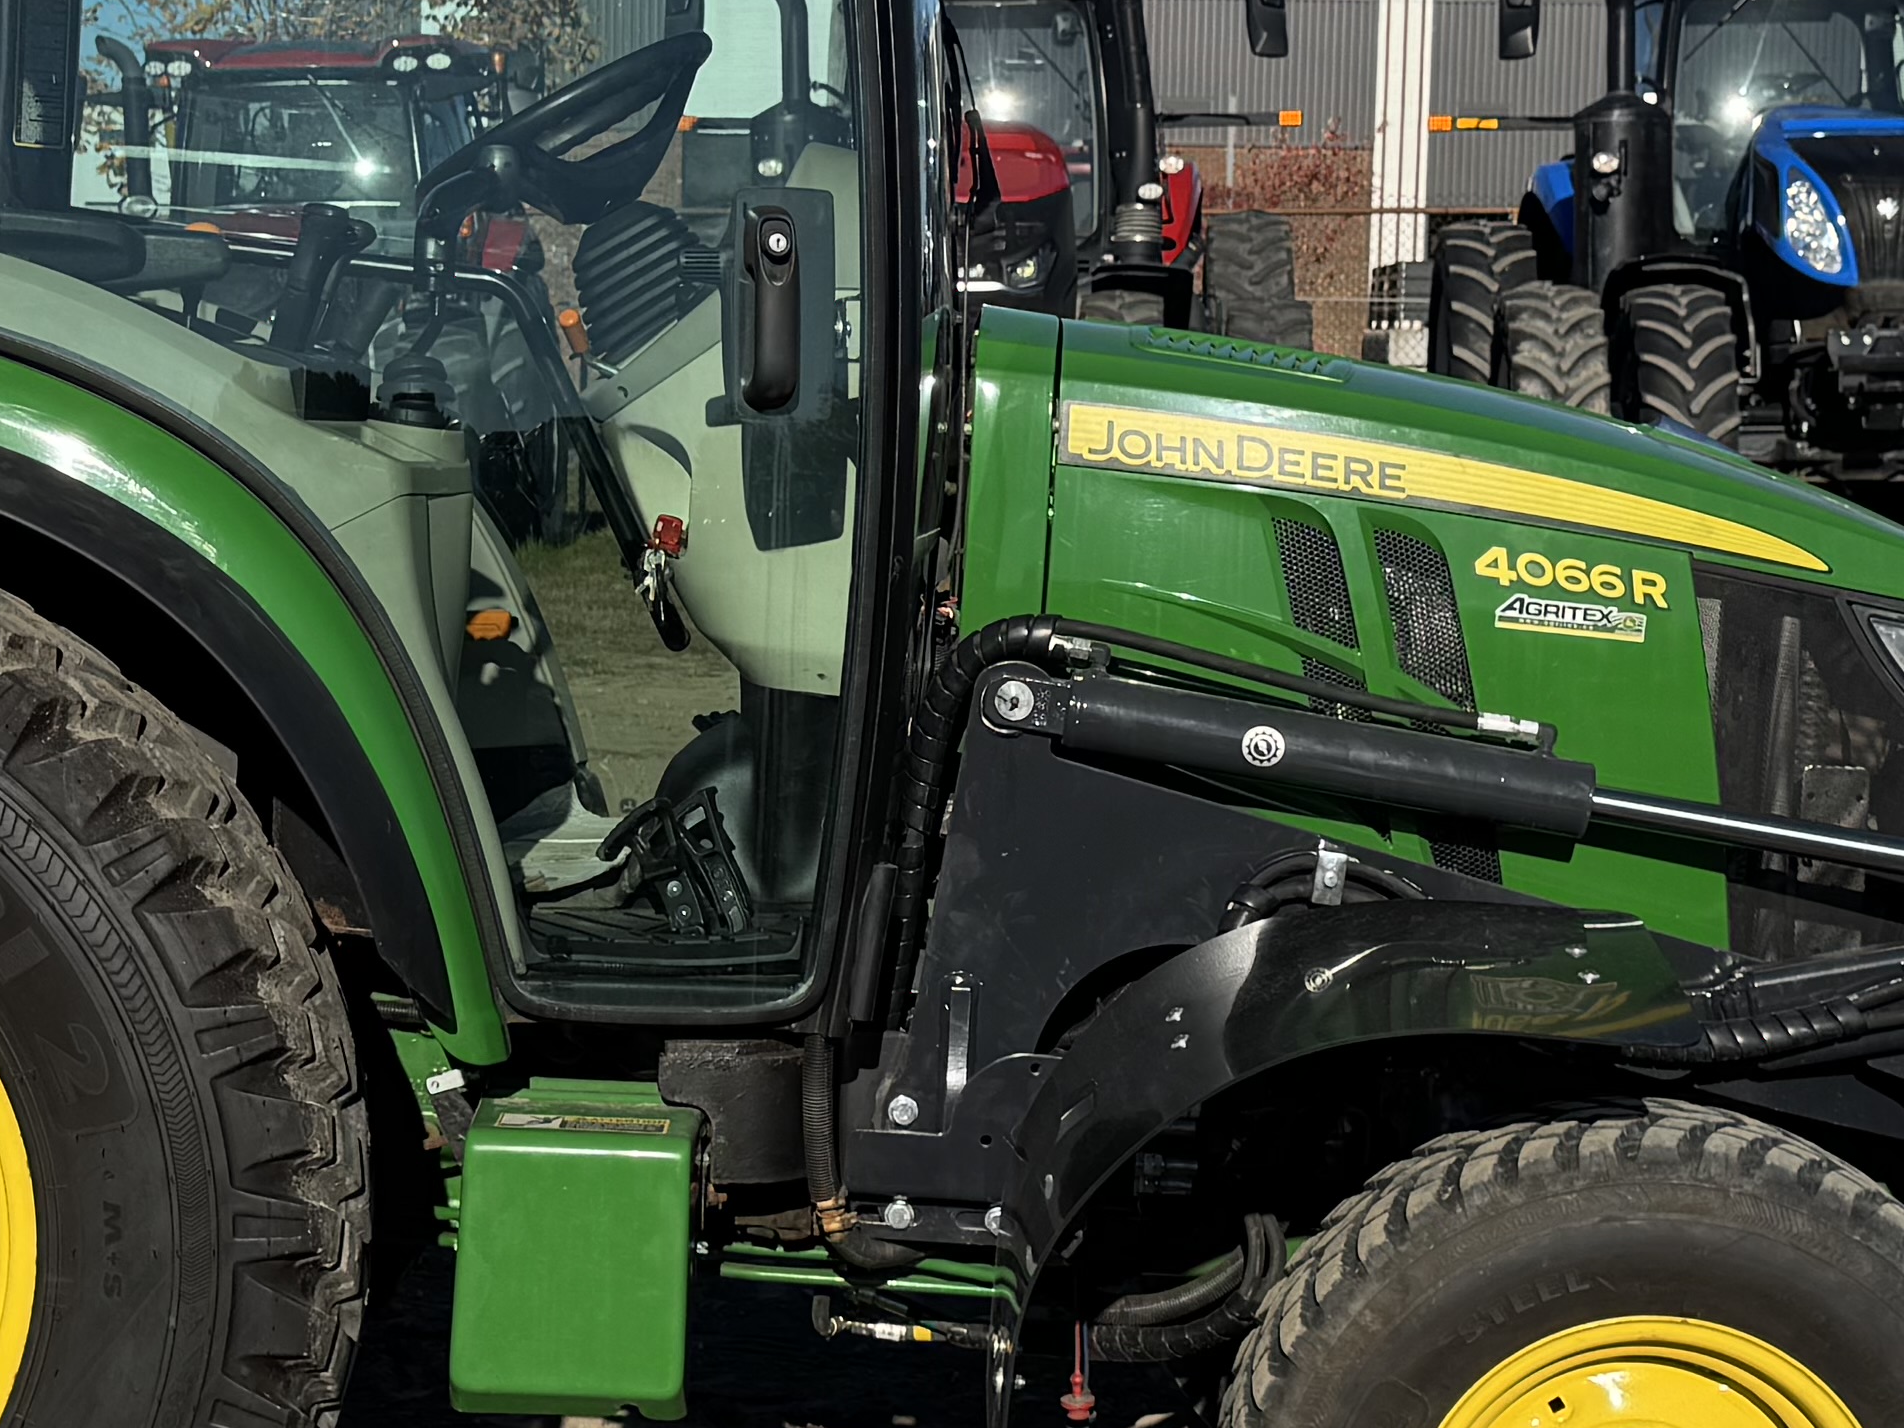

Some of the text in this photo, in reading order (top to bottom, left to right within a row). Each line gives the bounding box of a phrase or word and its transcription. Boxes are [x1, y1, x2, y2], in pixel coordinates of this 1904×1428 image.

[1088, 420, 1407, 494] JOHN DEERE
[1475, 546, 1669, 609] 4066 R
[1500, 597, 1613, 624] AGRITEX
[31, 1021, 110, 1105] 2
